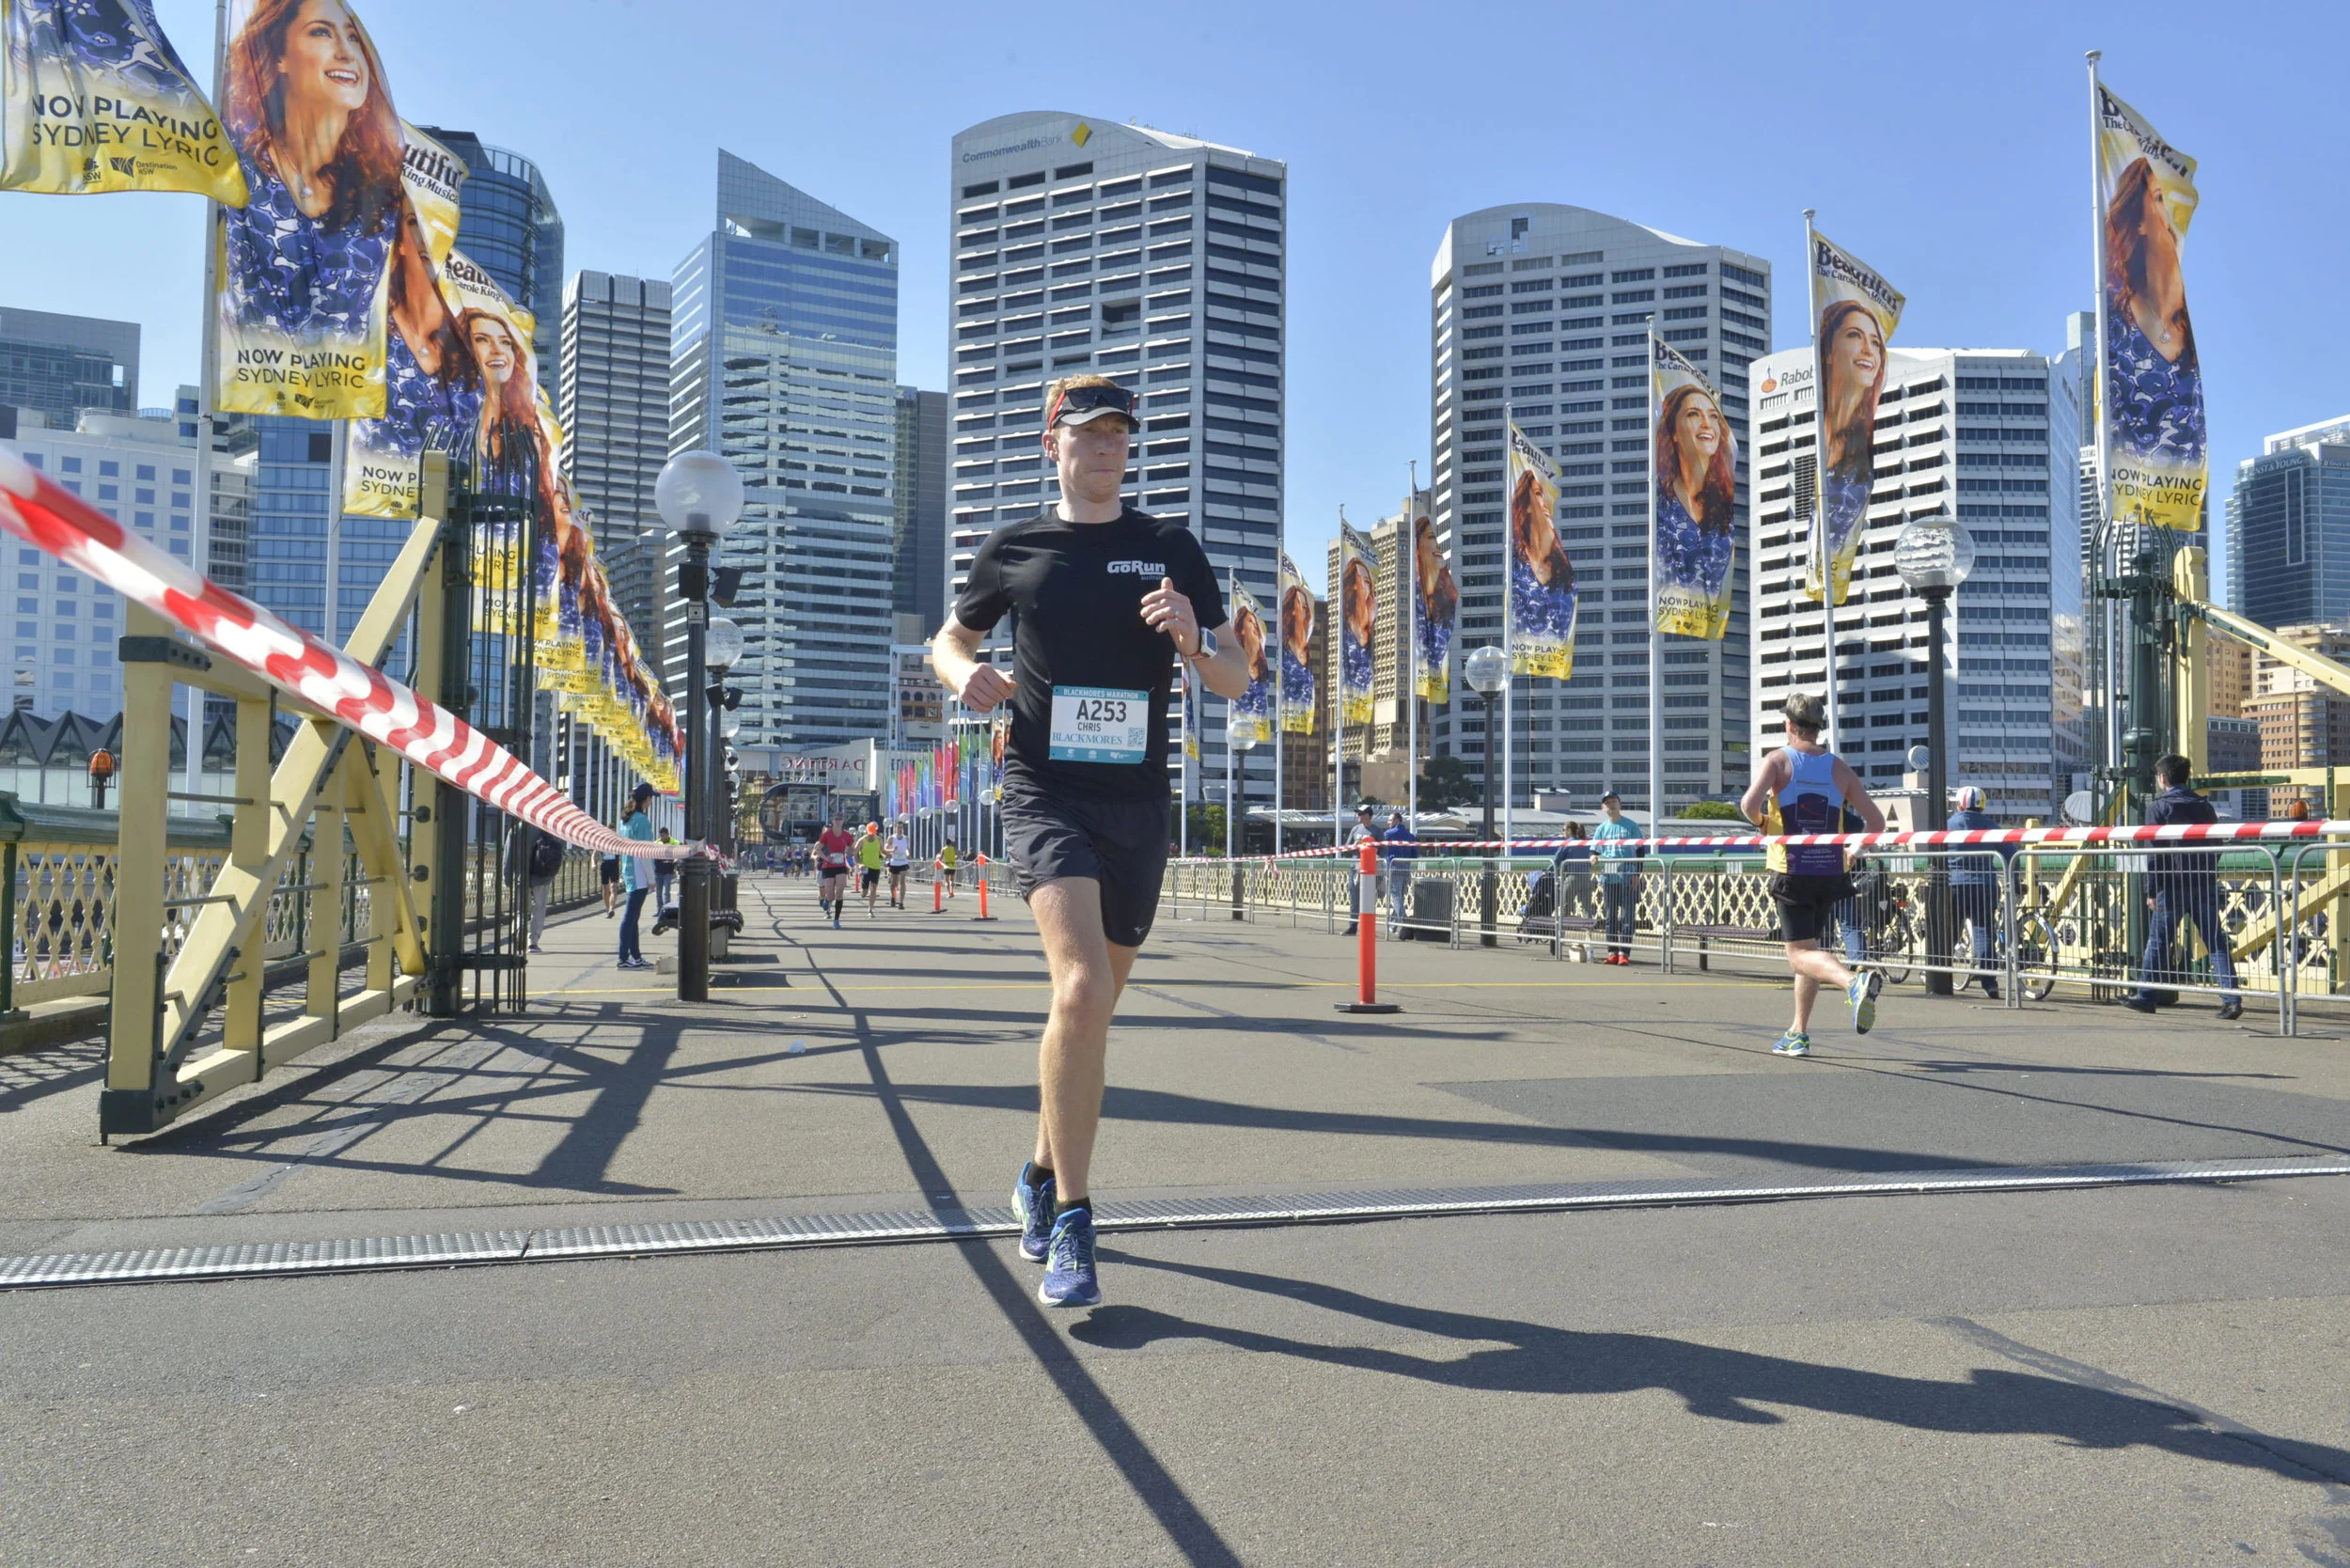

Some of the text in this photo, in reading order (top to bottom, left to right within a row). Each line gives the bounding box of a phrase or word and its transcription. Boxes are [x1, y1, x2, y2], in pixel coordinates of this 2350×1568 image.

[94, 96, 217, 140] PLAYING
[33, 122, 219, 166] SYDNEY LYRIC
[135, 161, 178, 170] Destination
[83, 171, 102, 182] NSW
[425, 176, 459, 206] Musica
[1817, 265, 1830, 278] The
[480, 286, 500, 302] King
[238, 350, 365, 370] NOW PLAYING
[238, 368, 364, 388] SYDNEY LYRIC
[2275, 455, 2304, 469] YOUNG
[363, 466, 402, 482] NOW
[2112, 483, 2200, 506] YDNEY LYRIC
[1107, 560, 1166, 575] GoRun
[1659, 596, 1682, 605] NOW
[1658, 606, 1693, 617] SYDNEY
[545, 640, 581, 651] PLAYING
[557, 648, 580, 658] LYRIC
[1512, 652, 1545, 661] SYDNEY
[547, 672, 598, 683] SYDNEY LYRIC
[1064, 688, 1138, 699] BLACKMORES MARATHON
[1076, 699, 1127, 723] A253
[1077, 722, 1102, 732] CHRIS
[1053, 732, 1122, 745] BLACKMORES
